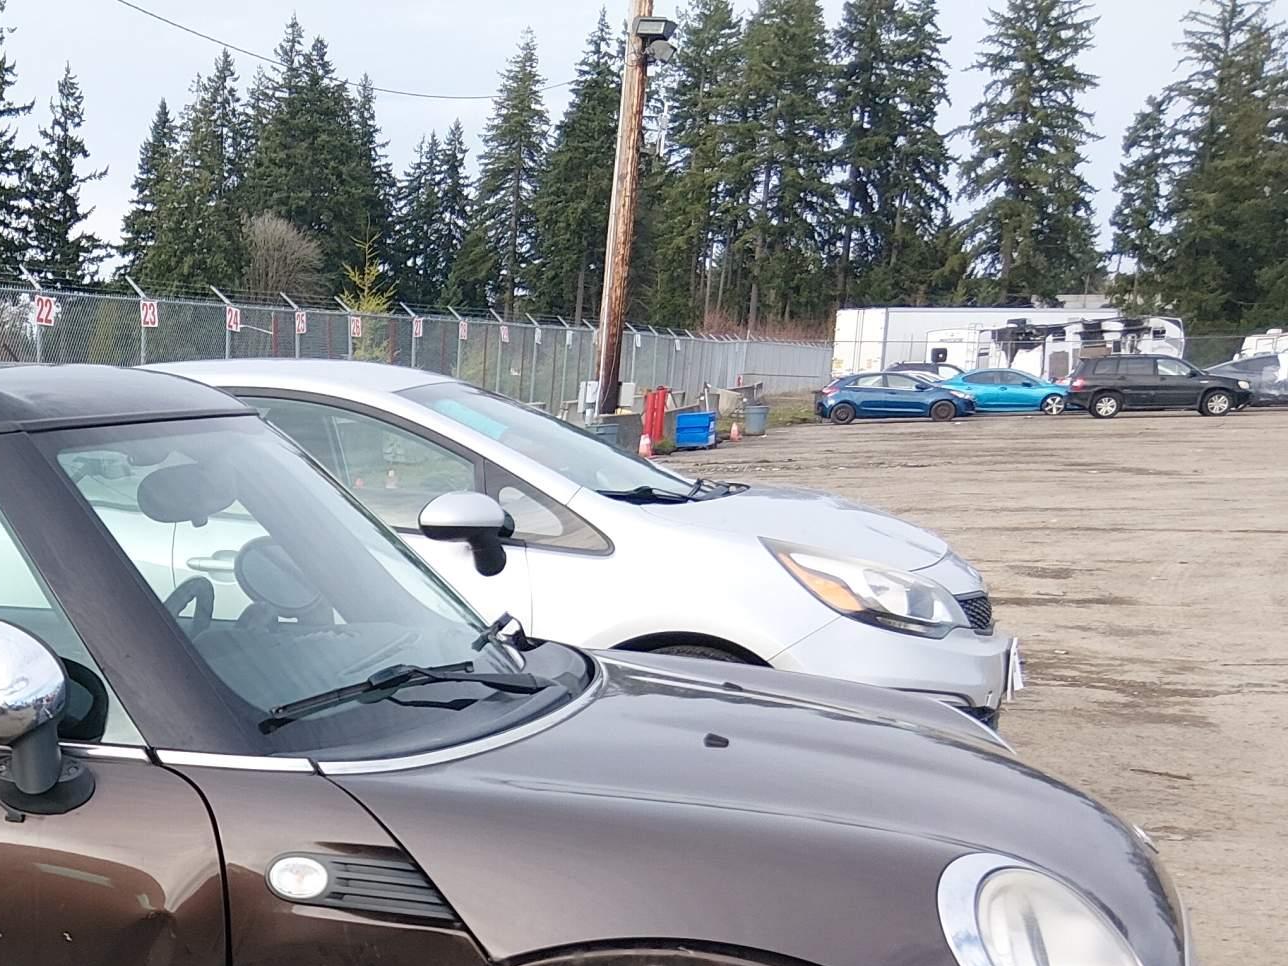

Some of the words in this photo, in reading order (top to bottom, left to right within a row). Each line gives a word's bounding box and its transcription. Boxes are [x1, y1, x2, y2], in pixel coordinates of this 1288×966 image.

[35, 297, 54, 325] 22
[142, 302, 157, 326] 23
[227, 309, 239, 331] 24
[295, 313, 306, 333] 25
